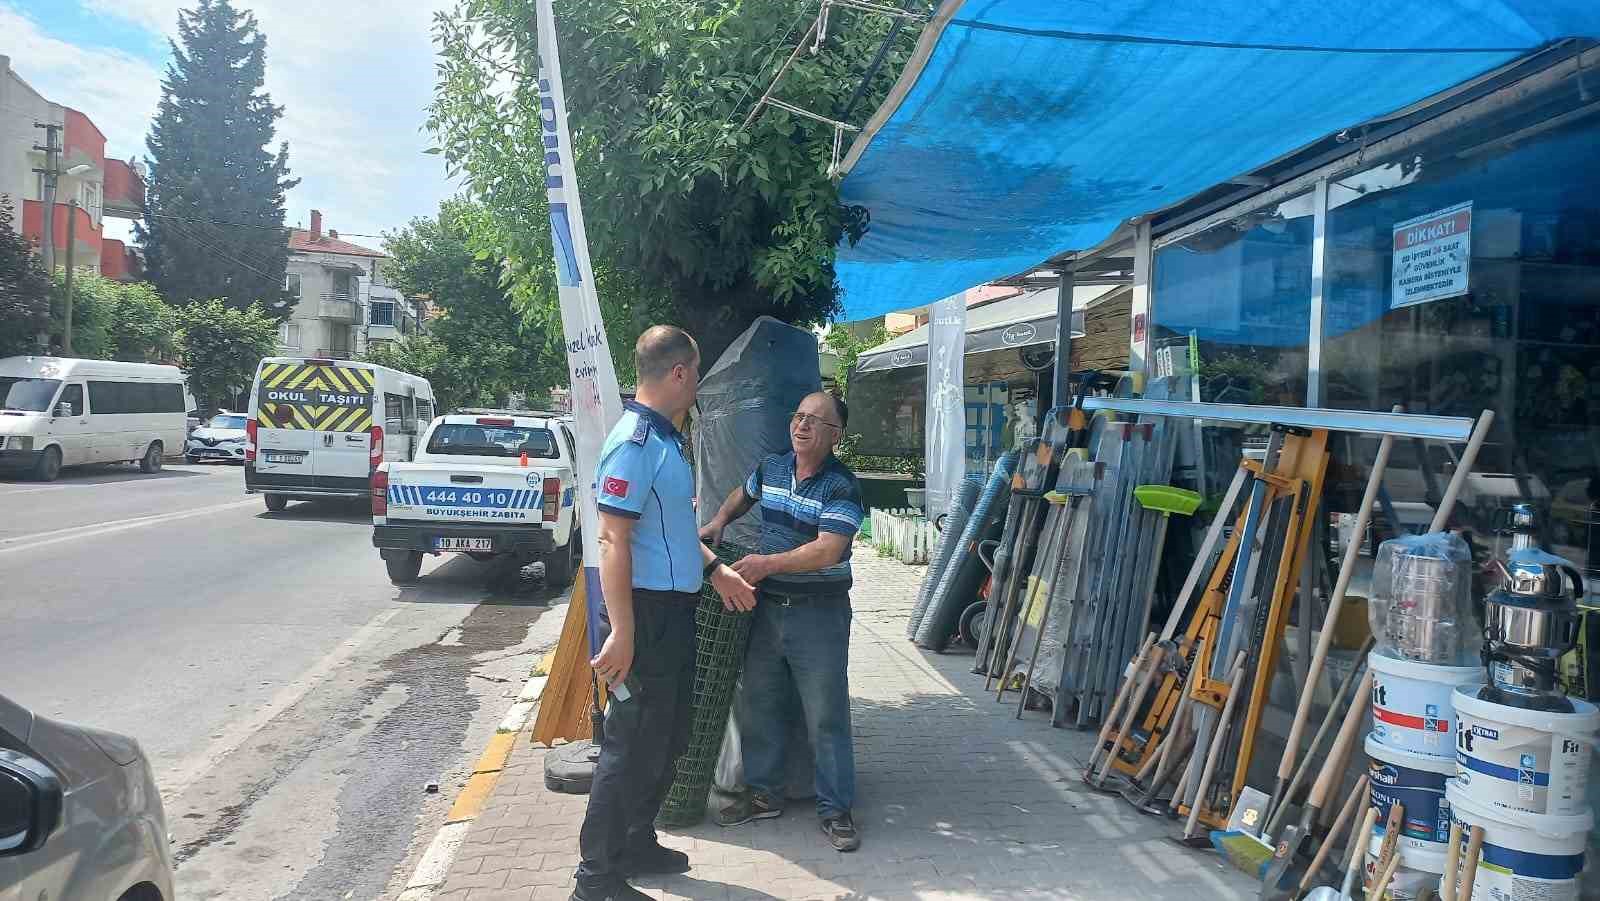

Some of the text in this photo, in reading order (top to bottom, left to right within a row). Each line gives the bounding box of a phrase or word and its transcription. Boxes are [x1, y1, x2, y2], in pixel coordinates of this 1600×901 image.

[268, 391, 364, 405] OKUL TAŞITI
[427, 491, 506, 505] 444 40 10
